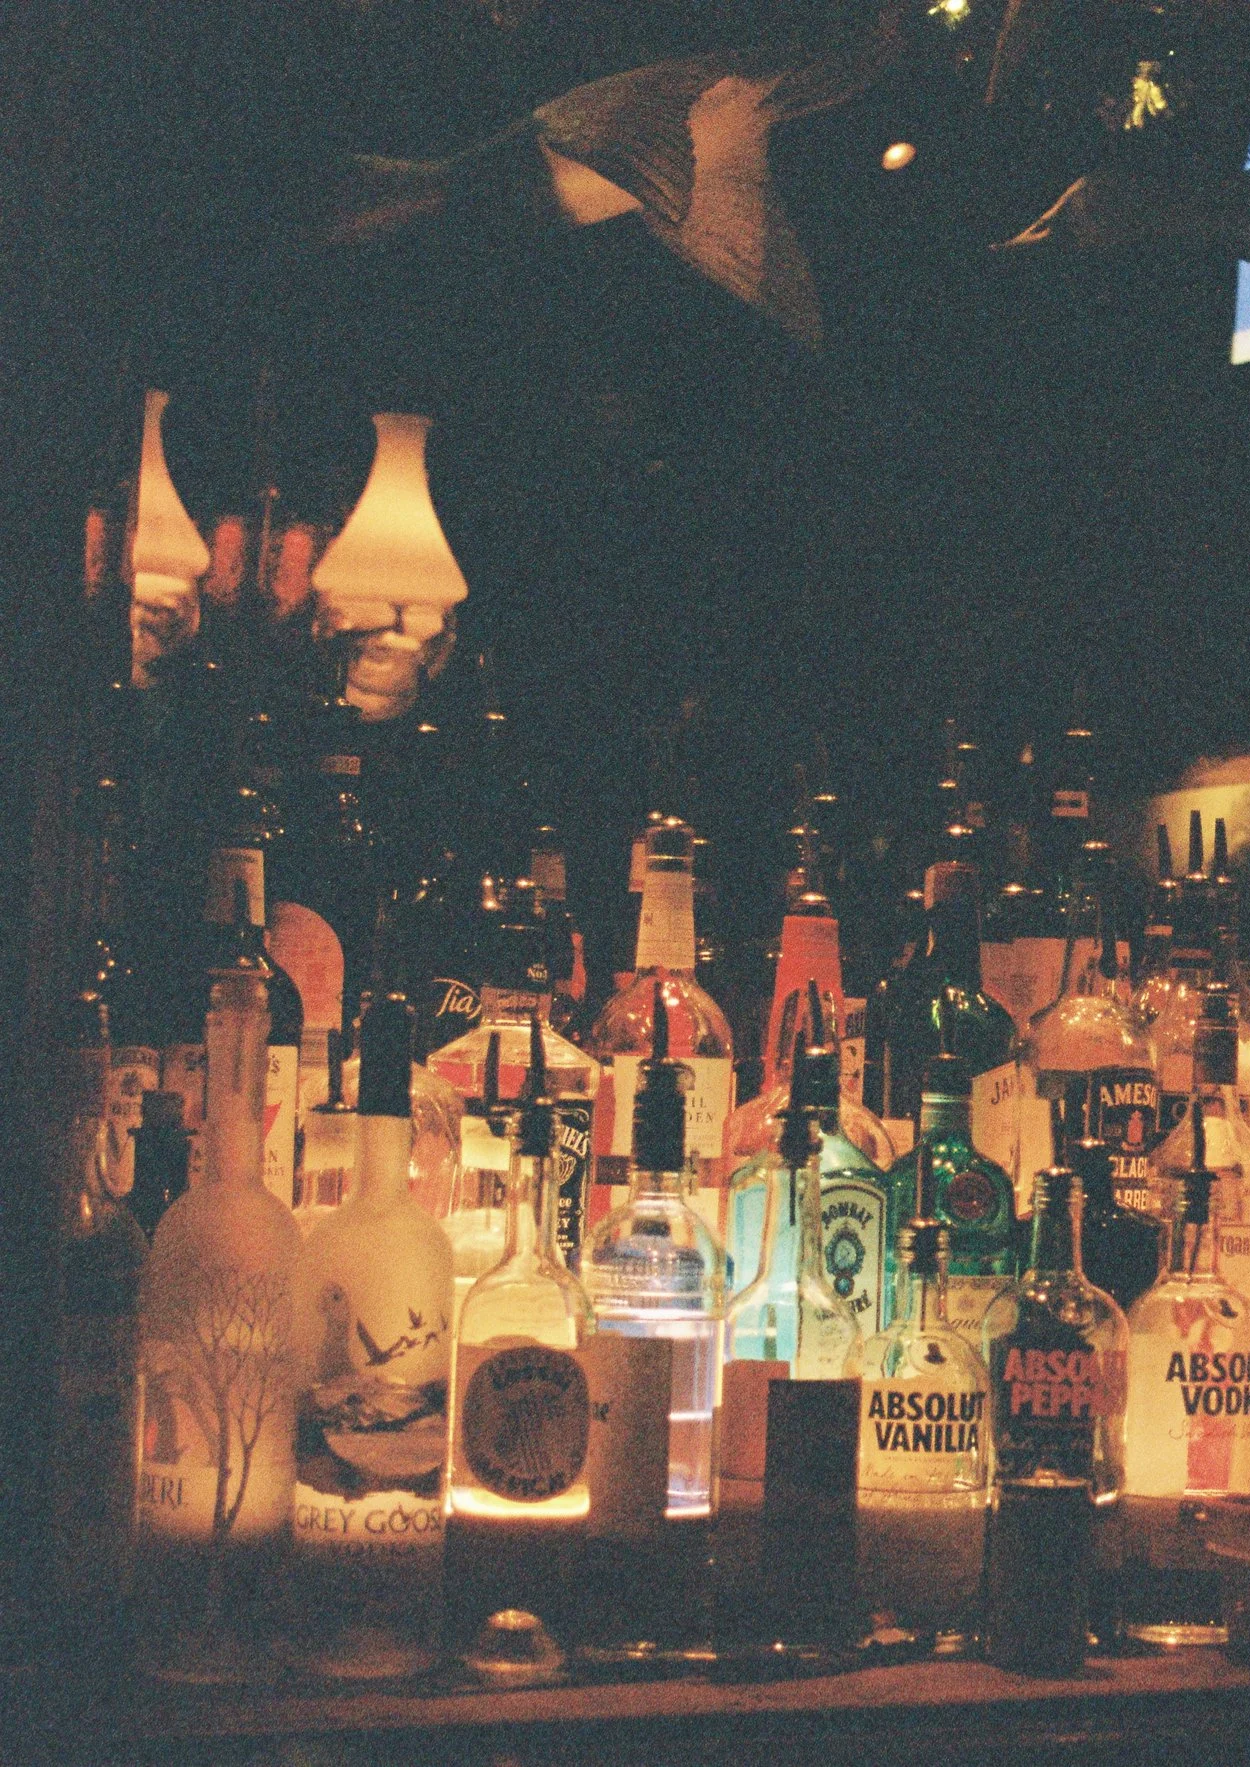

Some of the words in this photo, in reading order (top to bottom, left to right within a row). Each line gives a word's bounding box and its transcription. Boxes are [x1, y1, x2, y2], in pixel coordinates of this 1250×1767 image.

[1100, 1083, 1157, 1107] AMES
[868, 1391, 985, 1422] ABSOLUT
[296, 1504, 354, 1533] GREY
